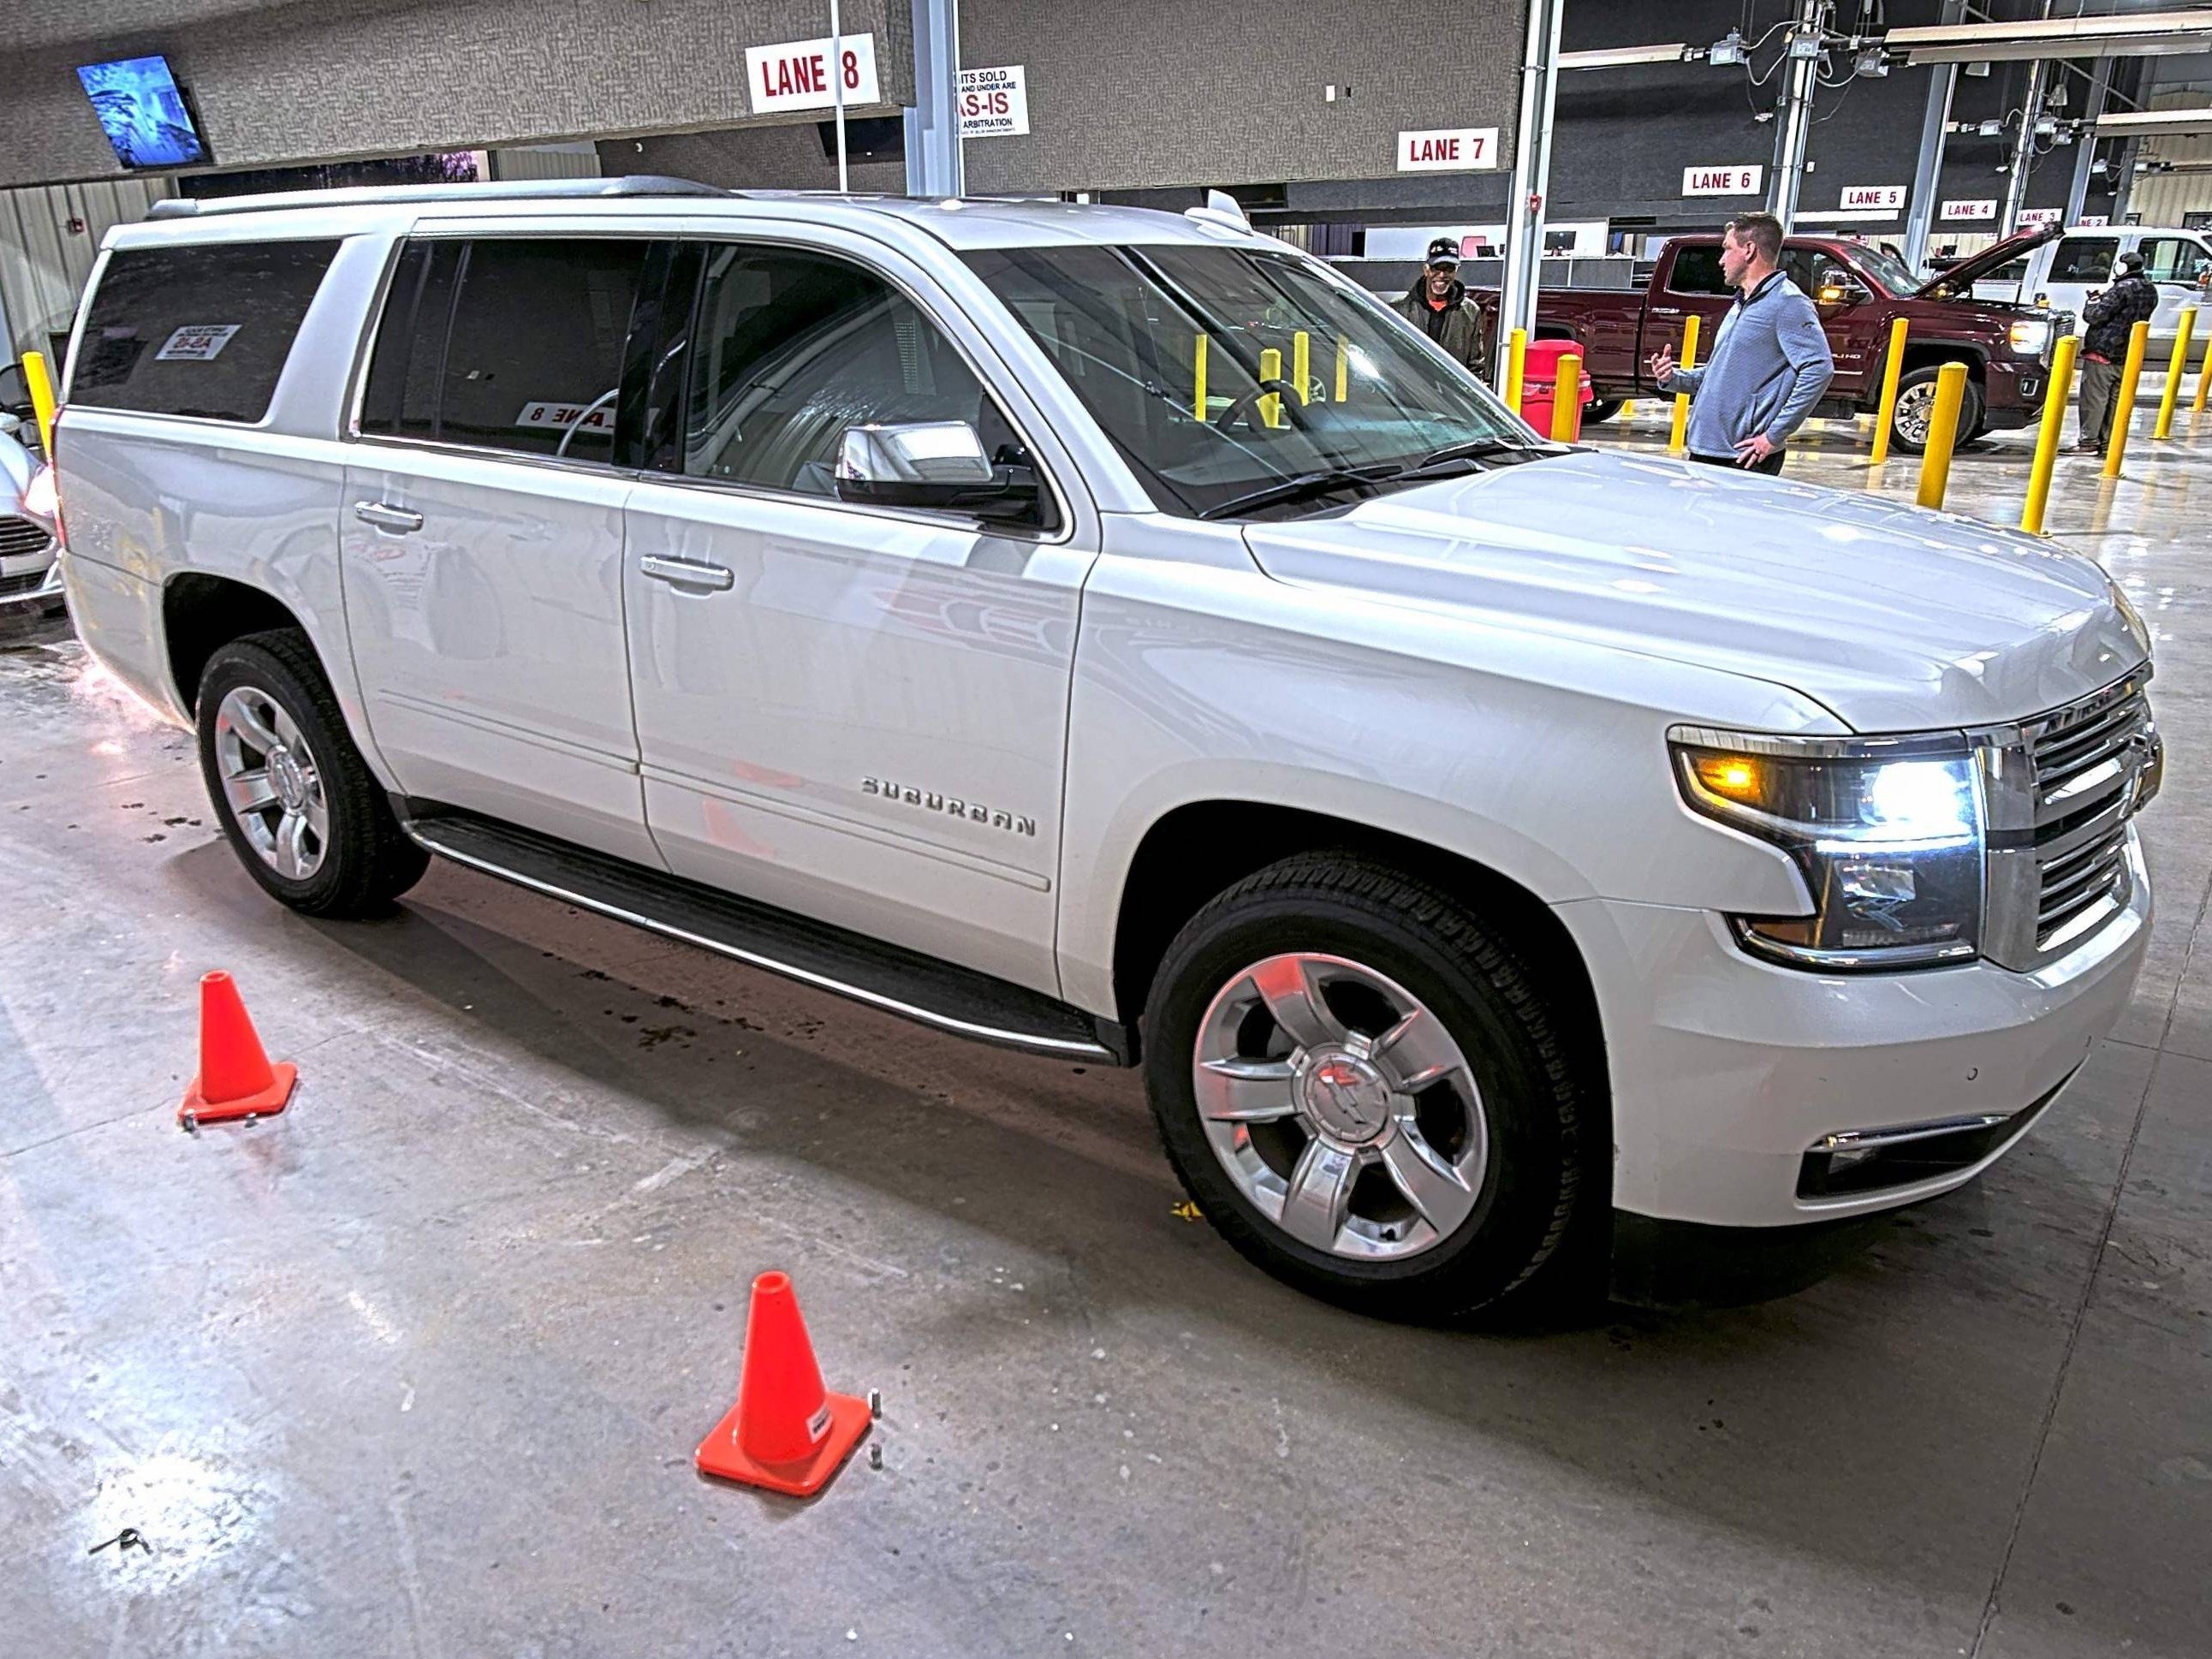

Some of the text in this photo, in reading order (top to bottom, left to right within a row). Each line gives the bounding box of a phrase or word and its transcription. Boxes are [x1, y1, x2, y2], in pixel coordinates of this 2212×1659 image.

[762, 50, 859, 97] LANE 8
[960, 70, 1007, 84] ITS SOLD
[977, 82, 1001, 92] UNDER
[1002, 81, 1017, 90] ARE
[963, 117, 1013, 128] ARBITRATION
[1410, 138, 1484, 161] LANE 7
[1692, 172, 1751, 189] LANE 6
[1848, 191, 1897, 205] LANE 5
[1948, 204, 1989, 216] LANE 4
[2020, 212, 2055, 223] LANE 3
[862, 776, 1036, 837] SUBURBAN
